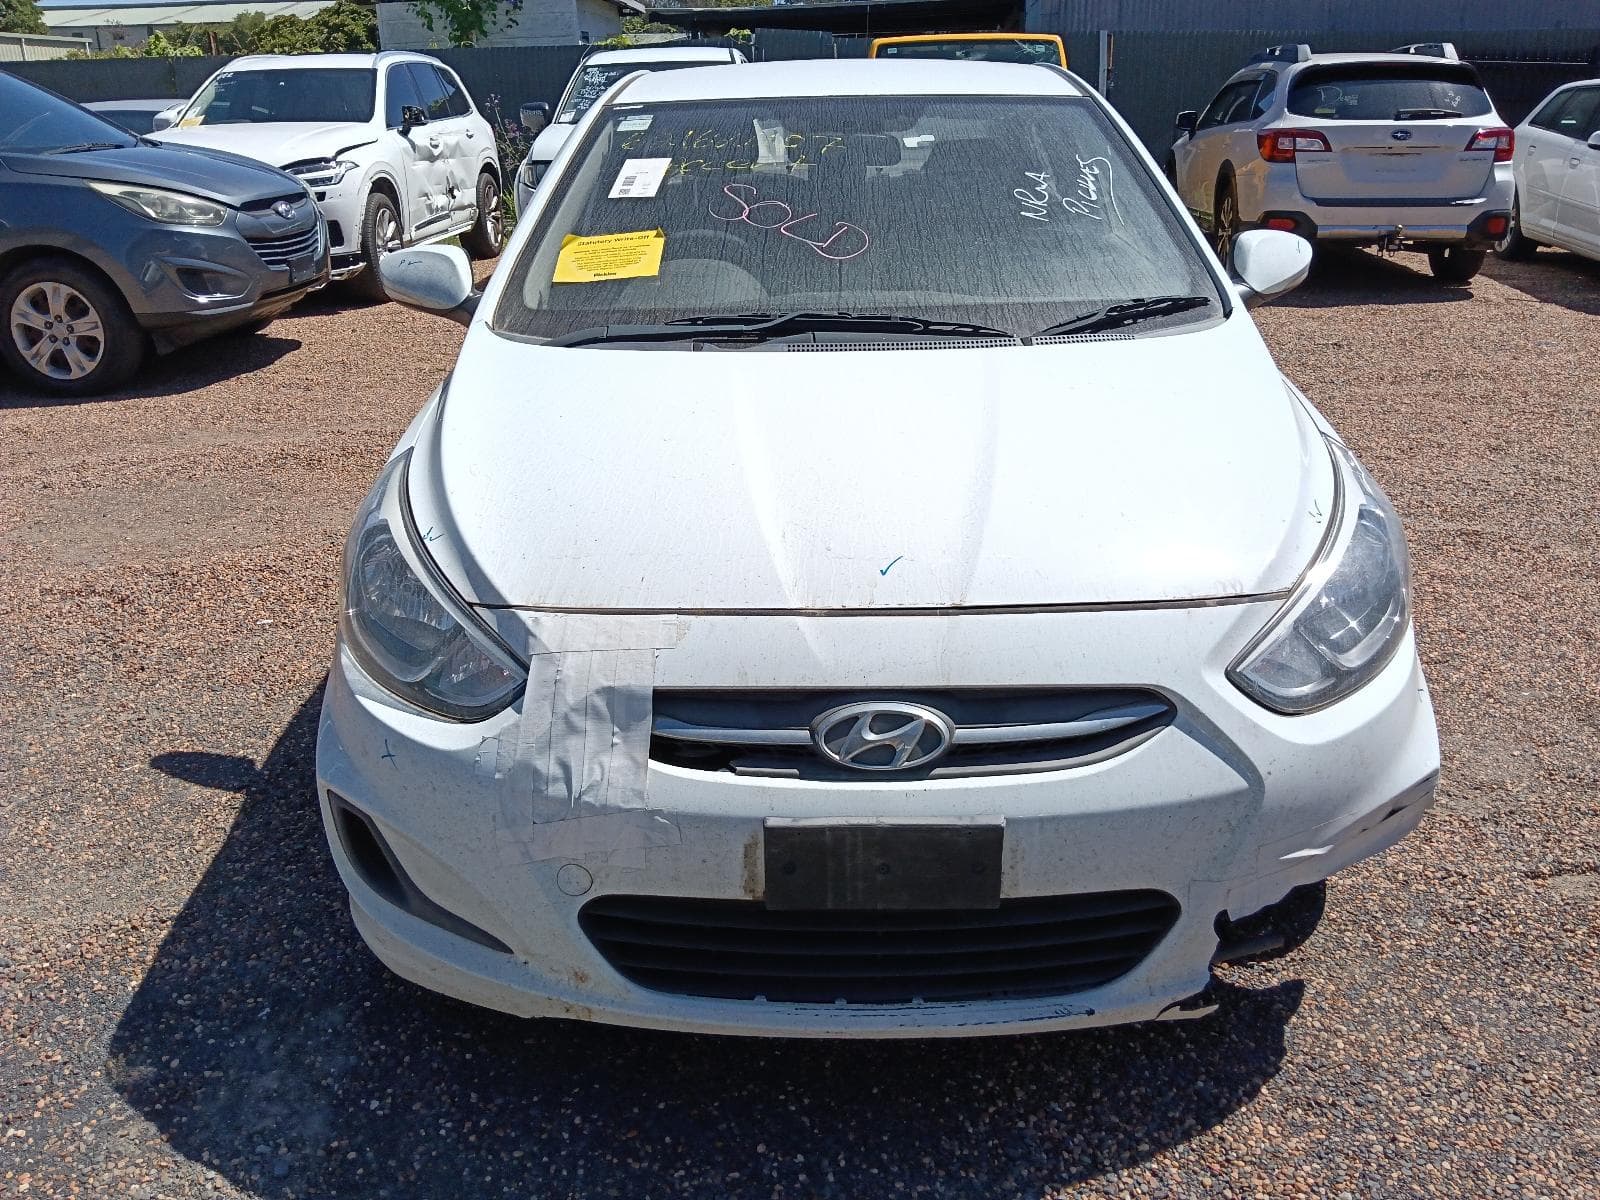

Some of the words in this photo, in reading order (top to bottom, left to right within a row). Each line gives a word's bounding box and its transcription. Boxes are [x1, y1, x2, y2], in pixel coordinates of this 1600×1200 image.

[577, 238, 613, 247] Statutory
[614, 234, 651, 242] Write-Off
[708, 184, 869, 259] SOLD
